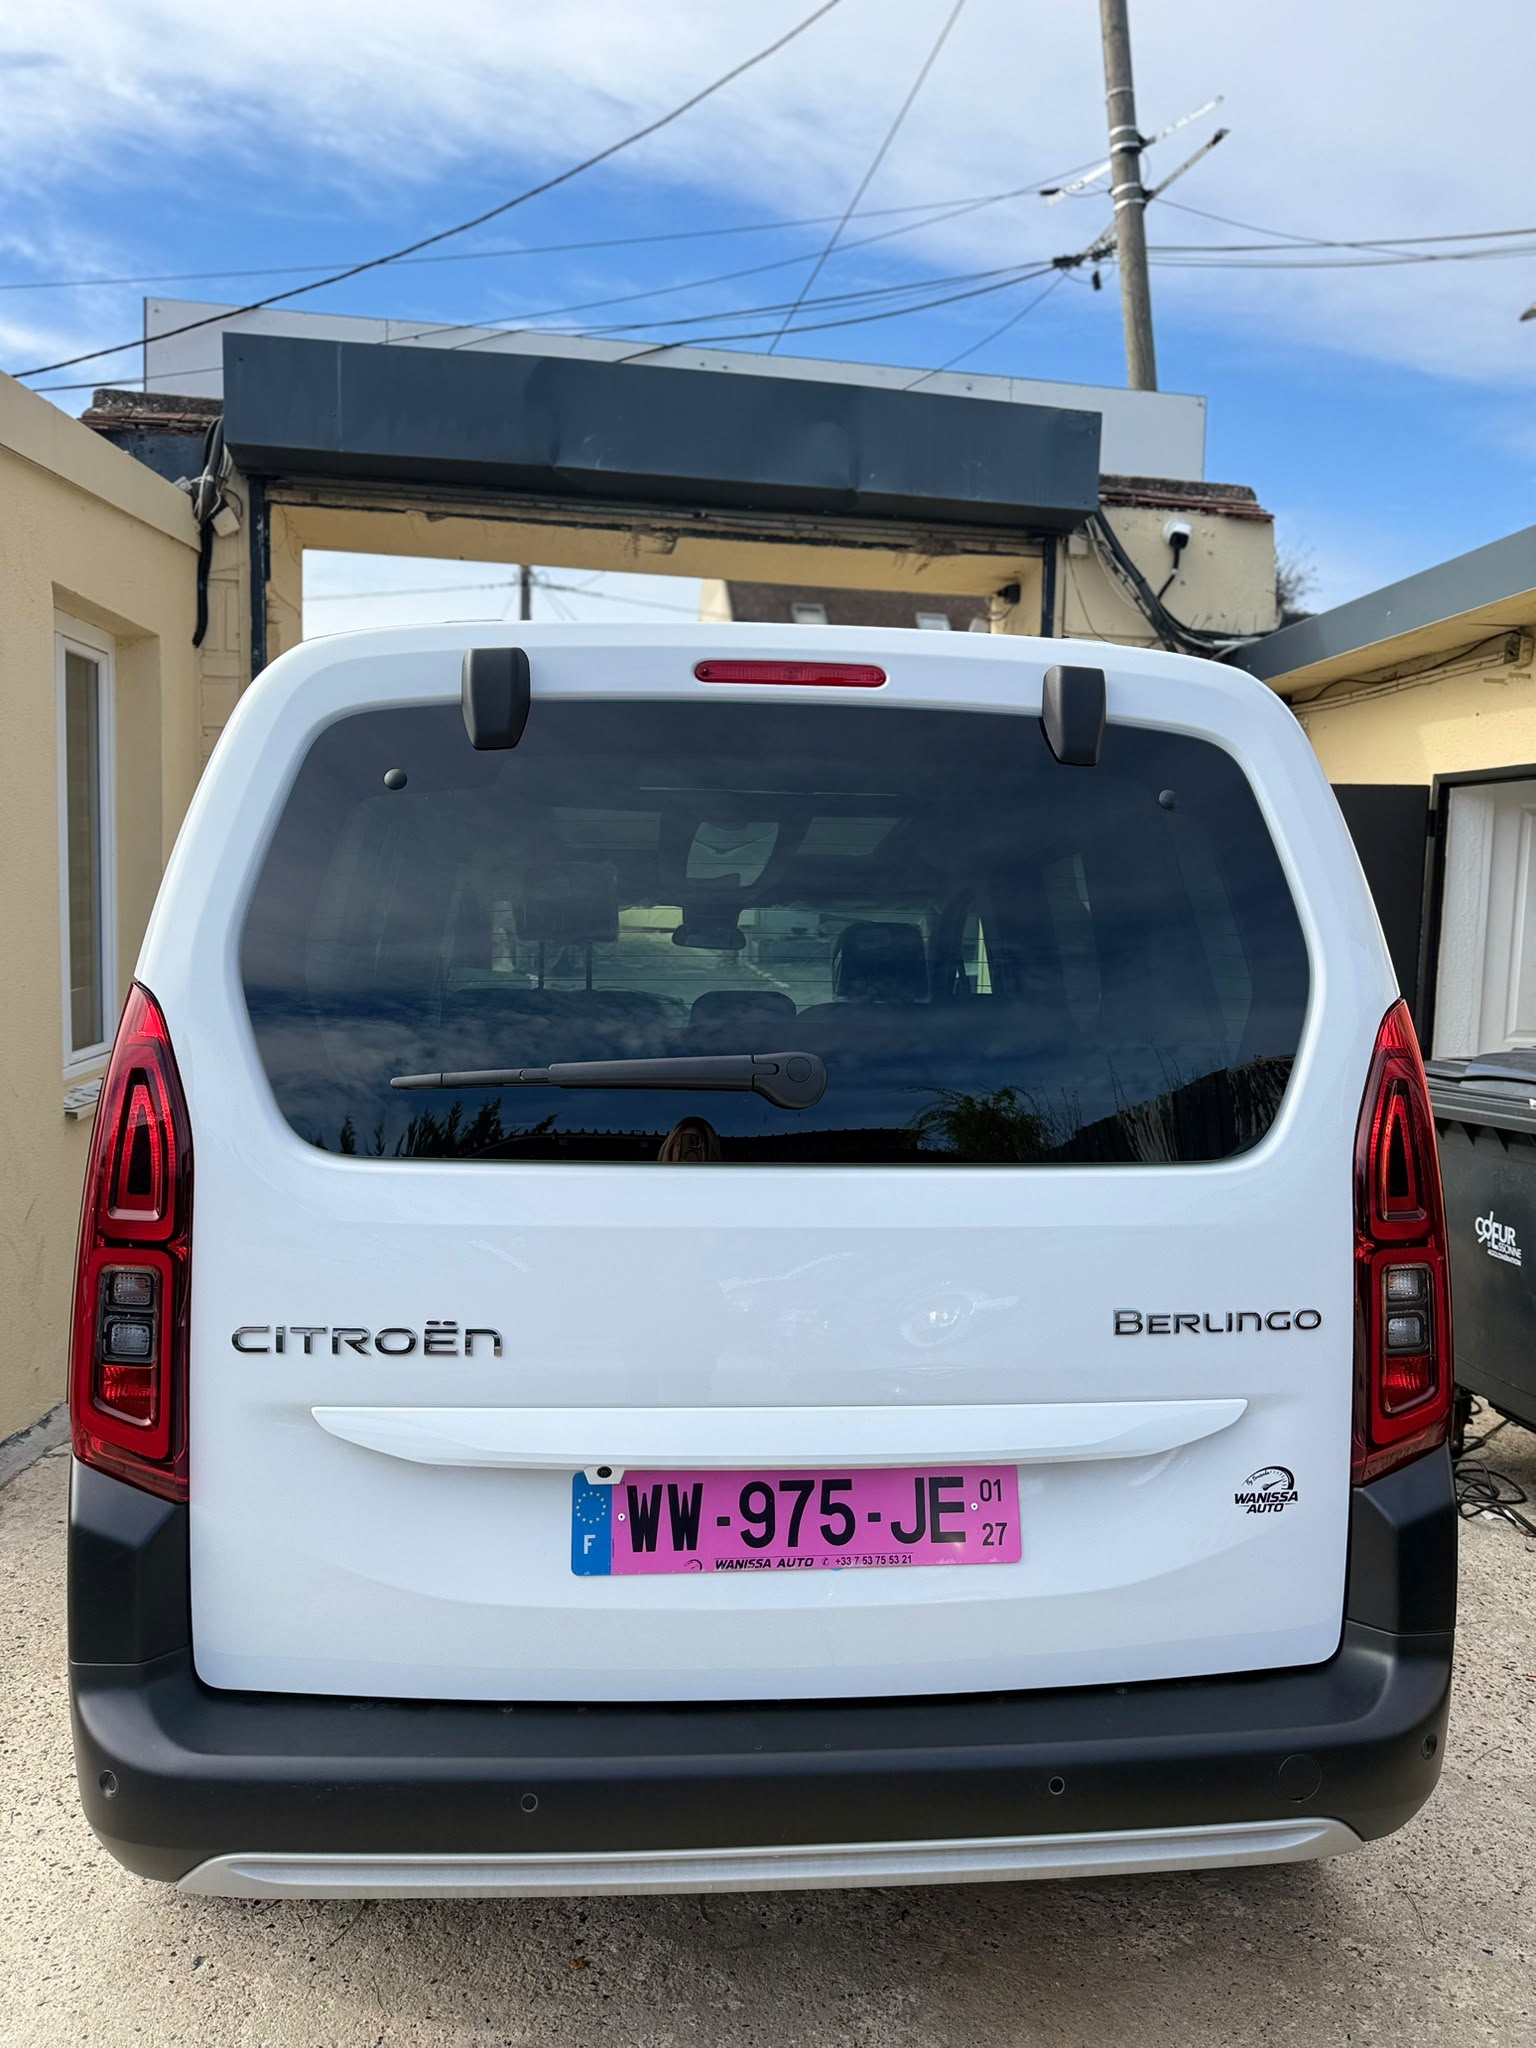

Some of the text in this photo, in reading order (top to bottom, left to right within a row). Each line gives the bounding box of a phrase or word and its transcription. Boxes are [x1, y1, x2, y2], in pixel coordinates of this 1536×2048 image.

[979, 1478, 1002, 1502] 01
[1234, 1490, 1299, 1505] WANISSA
[1246, 1502, 1285, 1514] AUTO
[982, 1522, 1008, 1546] 27
[583, 1534, 596, 1555] F
[715, 1554, 912, 1570] WANISSA AUTO +33 7 53 75 53 21
